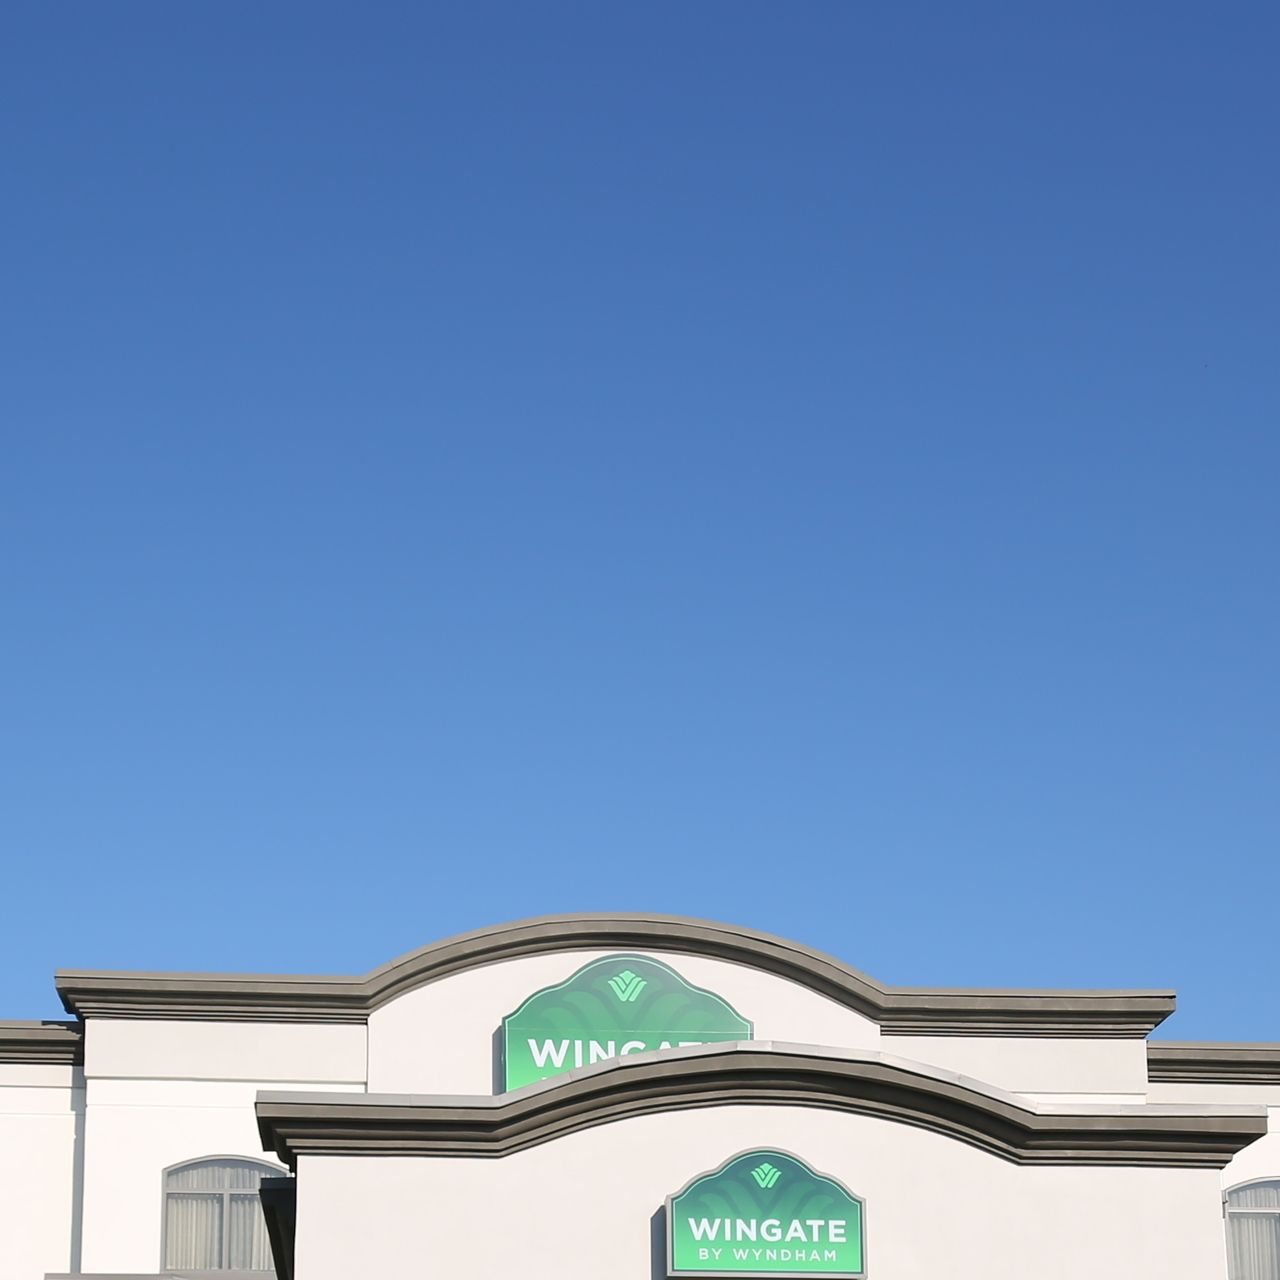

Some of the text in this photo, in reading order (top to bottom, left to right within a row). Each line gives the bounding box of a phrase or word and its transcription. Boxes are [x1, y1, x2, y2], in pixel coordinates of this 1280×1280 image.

[687, 1217, 848, 1243] WINGATE
[698, 1248, 838, 1262] BY WYNDHAM
